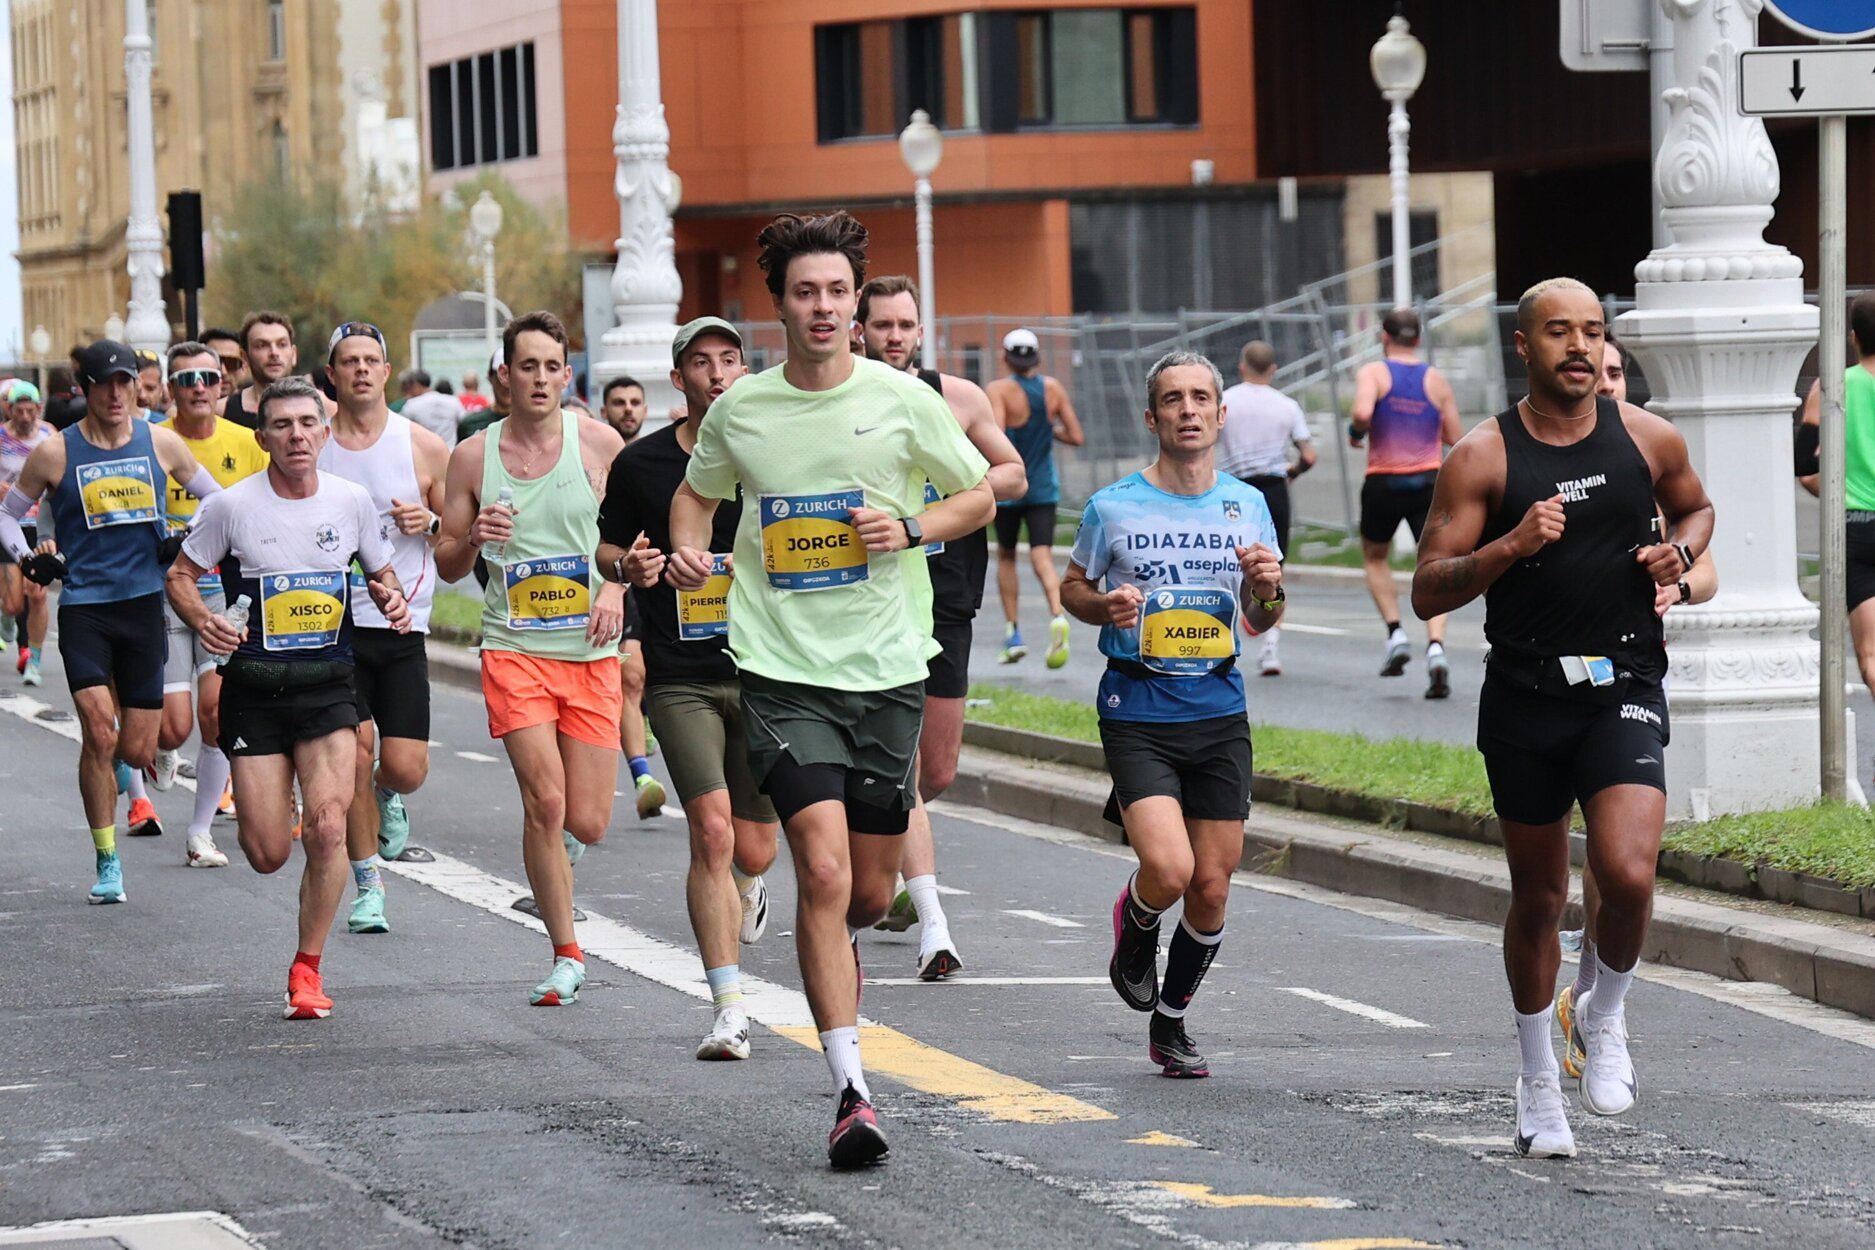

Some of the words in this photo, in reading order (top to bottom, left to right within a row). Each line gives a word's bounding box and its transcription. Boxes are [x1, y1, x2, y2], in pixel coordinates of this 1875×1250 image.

[1555, 473, 1607, 493] VITAMIN
[98, 486, 144, 499] DANIEL
[795, 499, 848, 513] ZURICH
[787, 533, 850, 551] JORGE
[535, 561, 576, 572] ZURICH
[767, 552, 775, 570] 42k
[803, 556, 830, 569] 736
[294, 576, 332, 587] ZURICH
[529, 588, 576, 602] PABLO
[1179, 595, 1221, 605] ZURICH
[289, 604, 332, 617] XISCO
[541, 606, 560, 616] 732
[298, 621, 322, 631] 1302
[1164, 627, 1220, 639] XABIER
[1178, 645, 1201, 656] 997
[1620, 710, 1648, 723] WELL
[1621, 704, 1662, 725] VITAMIN
